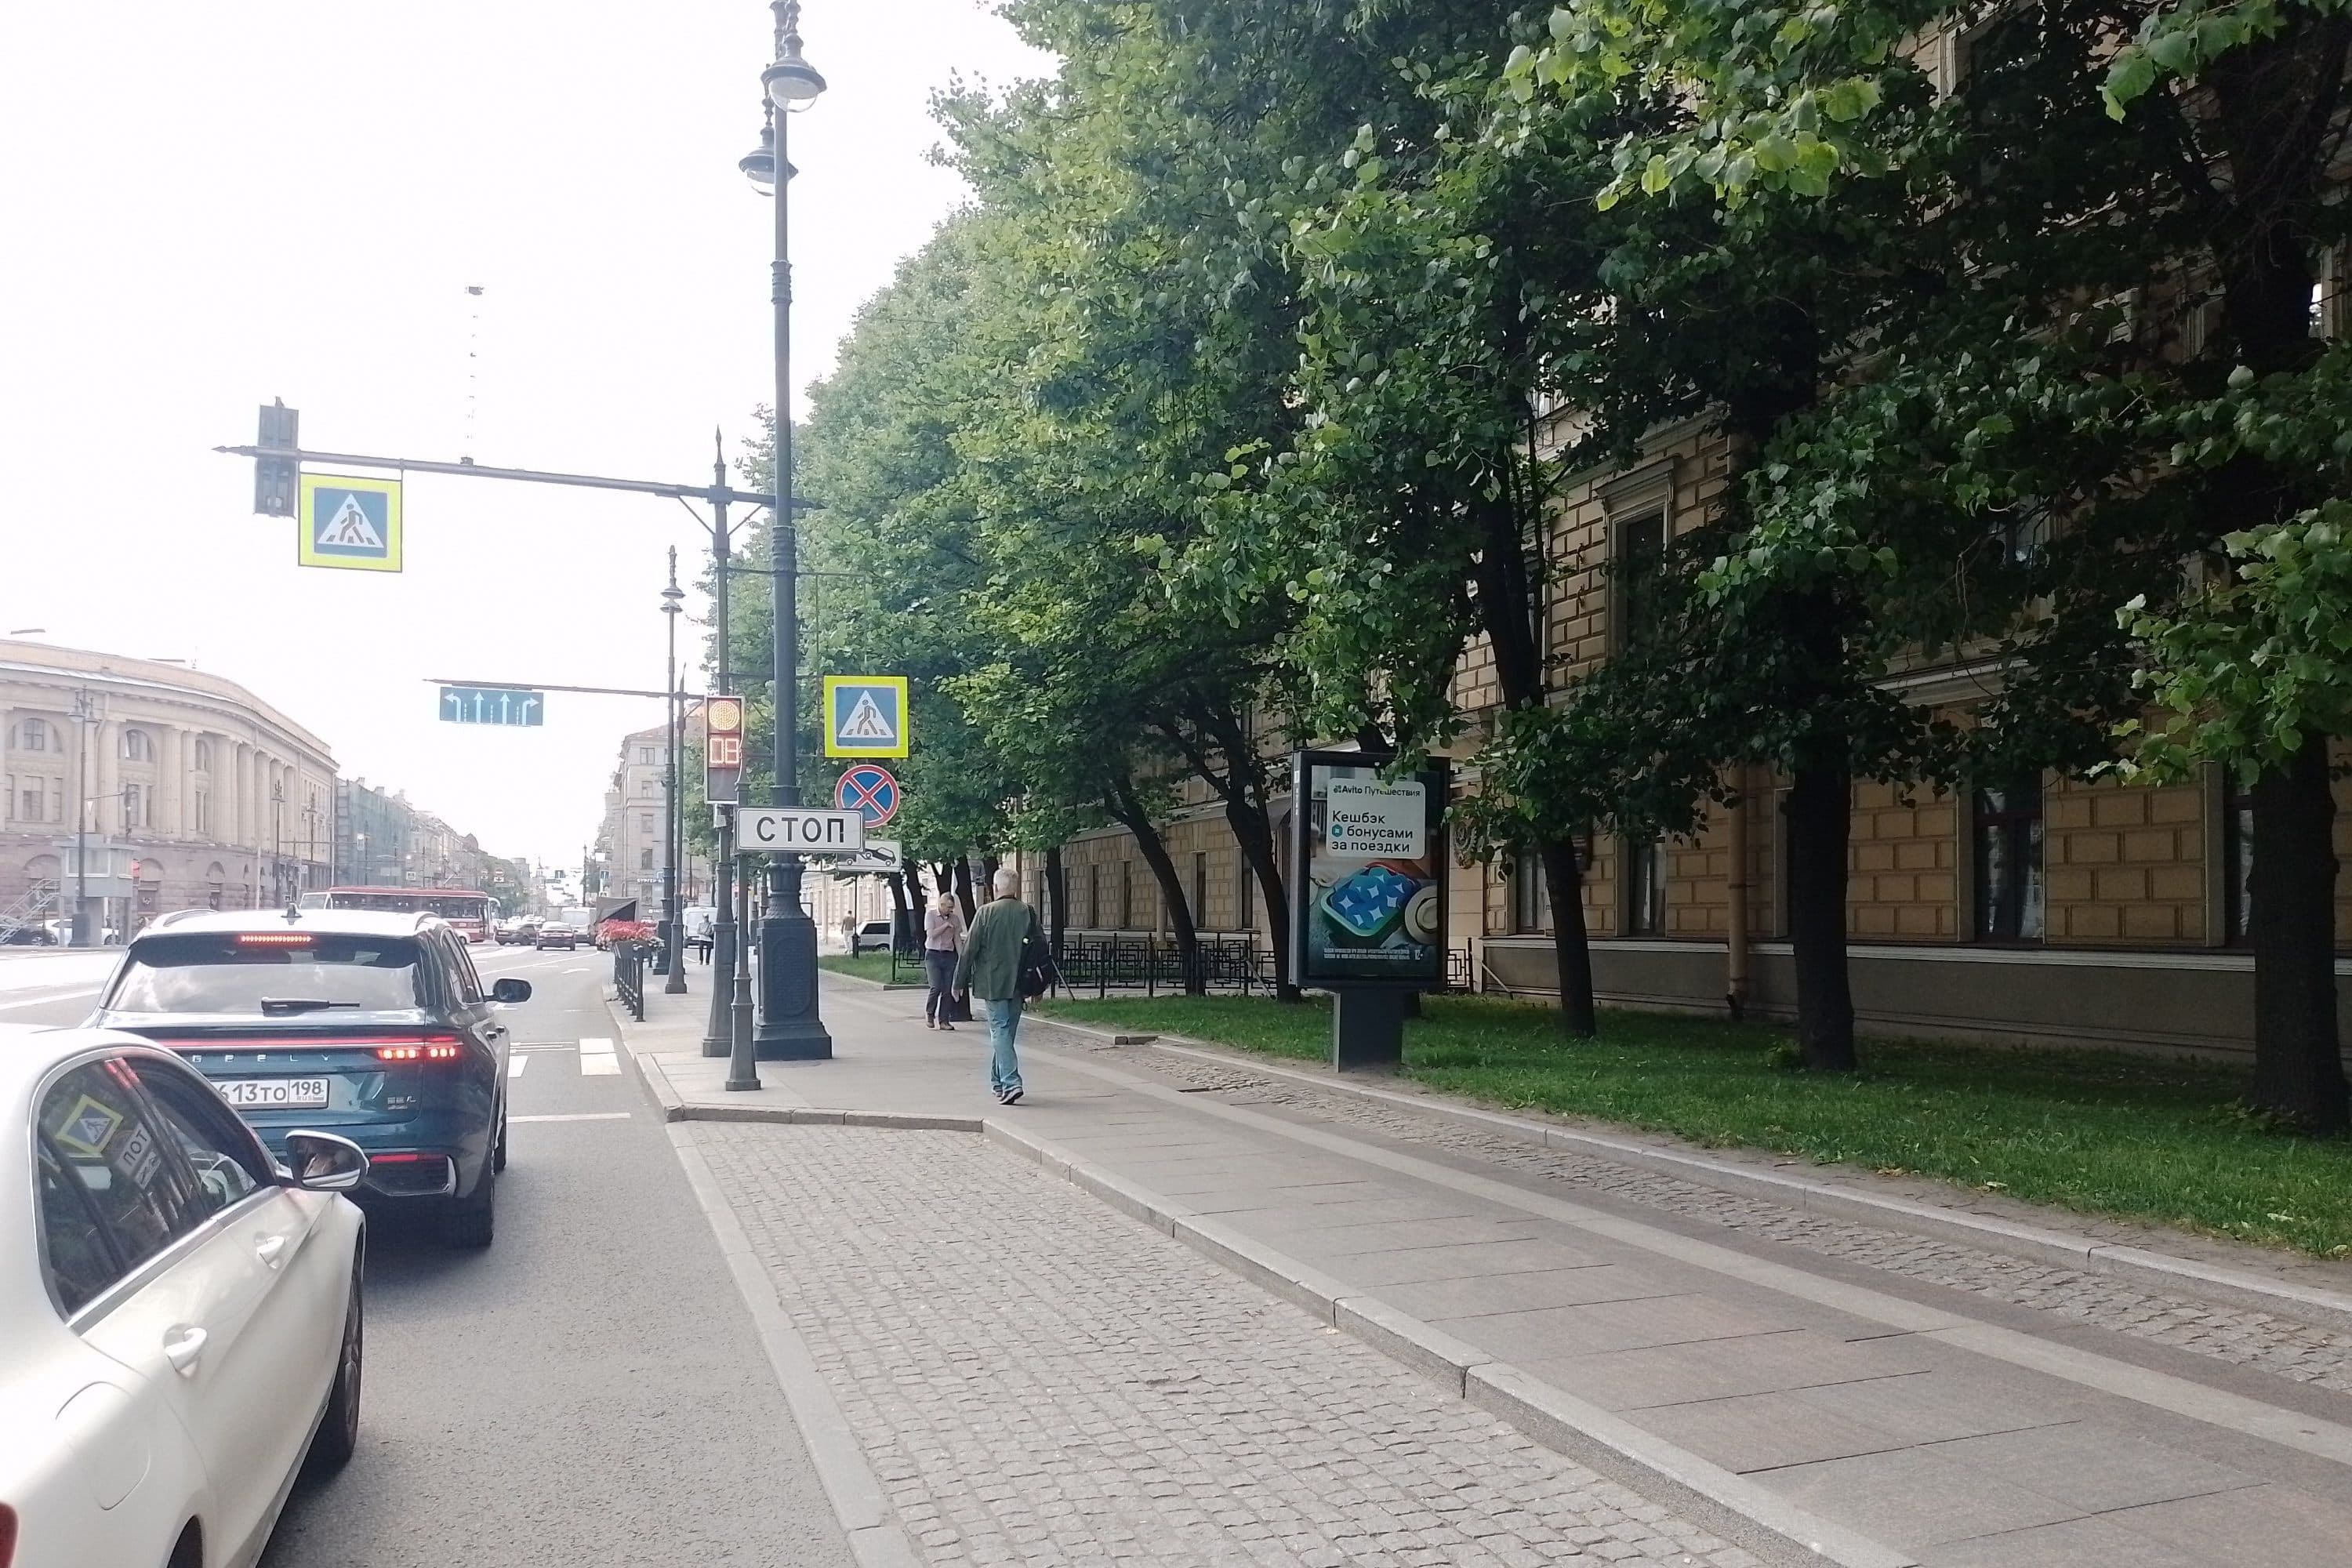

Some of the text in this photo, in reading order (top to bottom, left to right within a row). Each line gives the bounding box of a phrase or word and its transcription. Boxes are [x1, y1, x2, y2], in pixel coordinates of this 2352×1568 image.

[1342, 786, 1363, 794] Avito
[1333, 811, 1385, 824] Кешбэк
[757, 816, 844, 843] СТОП
[1347, 826, 1413, 840] бонусами
[1332, 841, 1410, 853] за поездки
[192, 1054, 330, 1063] GEELY
[291, 1081, 321, 1095] 198
